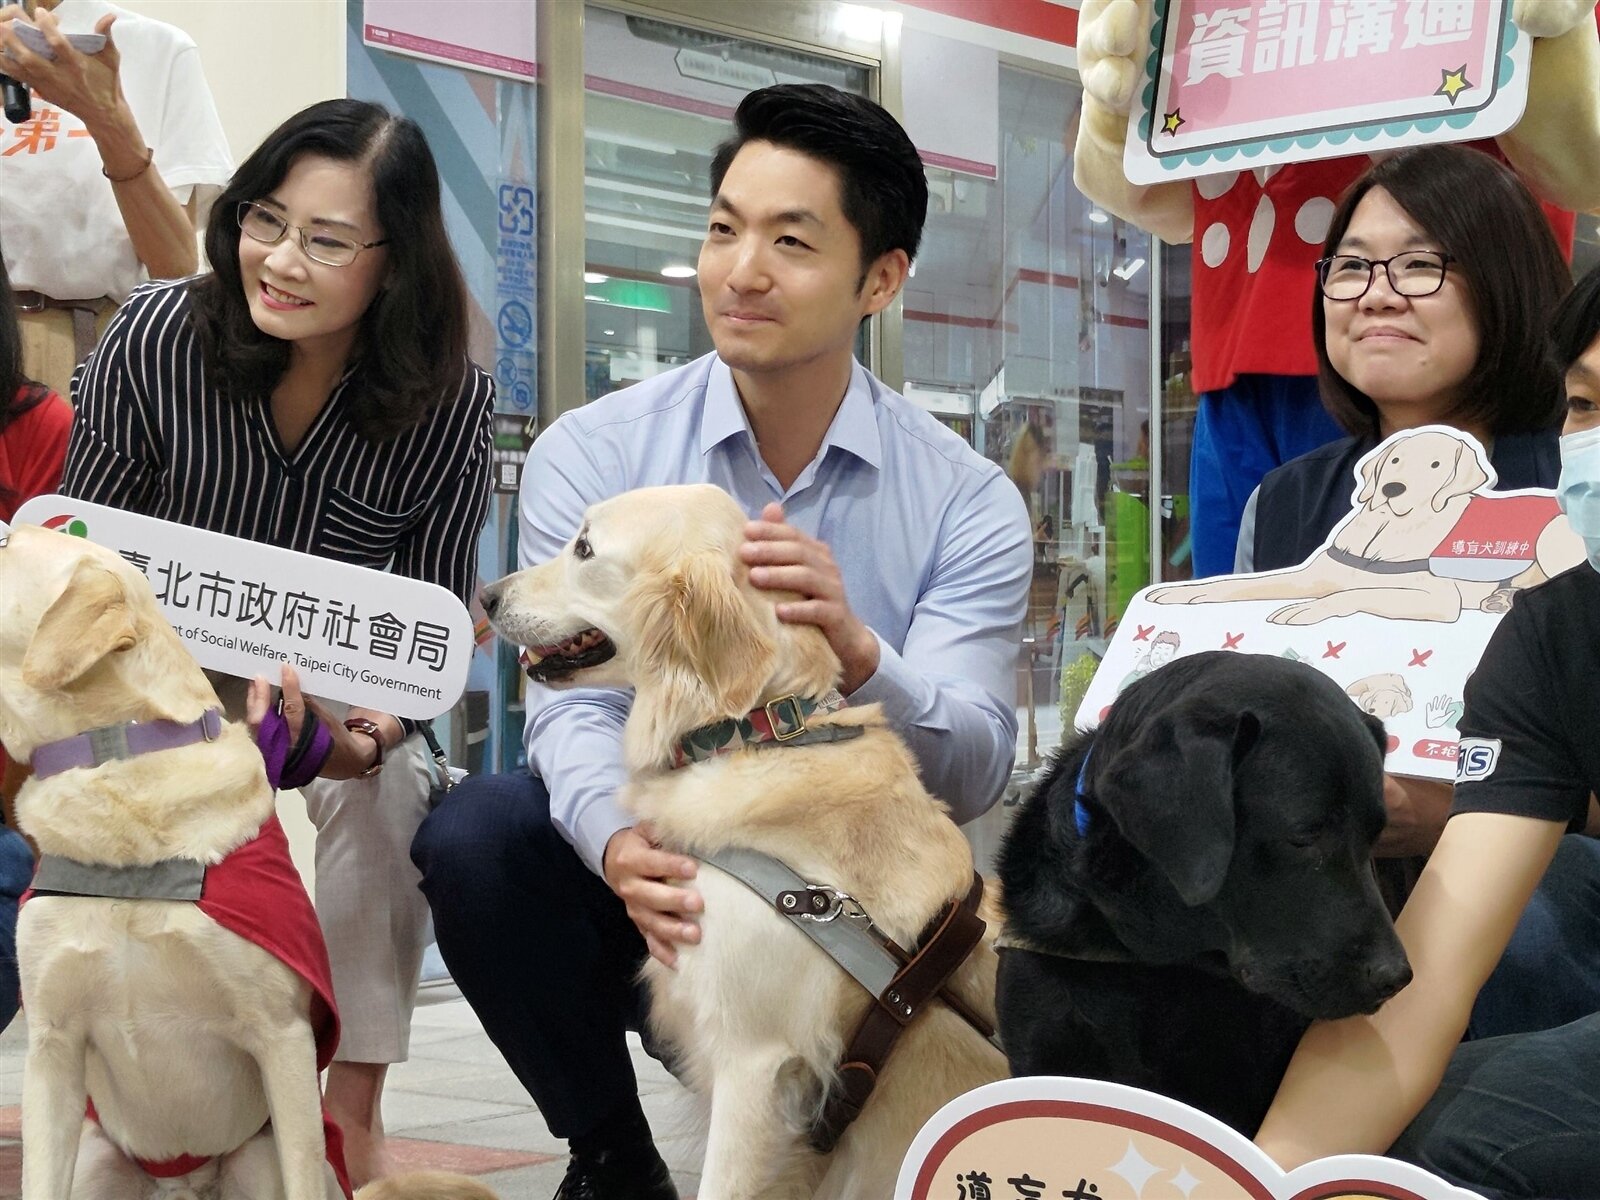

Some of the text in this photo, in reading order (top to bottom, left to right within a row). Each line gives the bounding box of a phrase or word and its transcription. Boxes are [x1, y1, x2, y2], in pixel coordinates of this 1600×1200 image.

[1182, 0, 1474, 88] 資訊溝通
[1451, 539, 1530, 556] 導盲犬訓練中
[186, 627, 200, 640] of
[200, 630, 238, 650] Social
[239, 639, 291, 664] Welfare,
[294, 652, 330, 673] Taipei
[333, 662, 358, 682] City
[360, 669, 442, 700] Government
